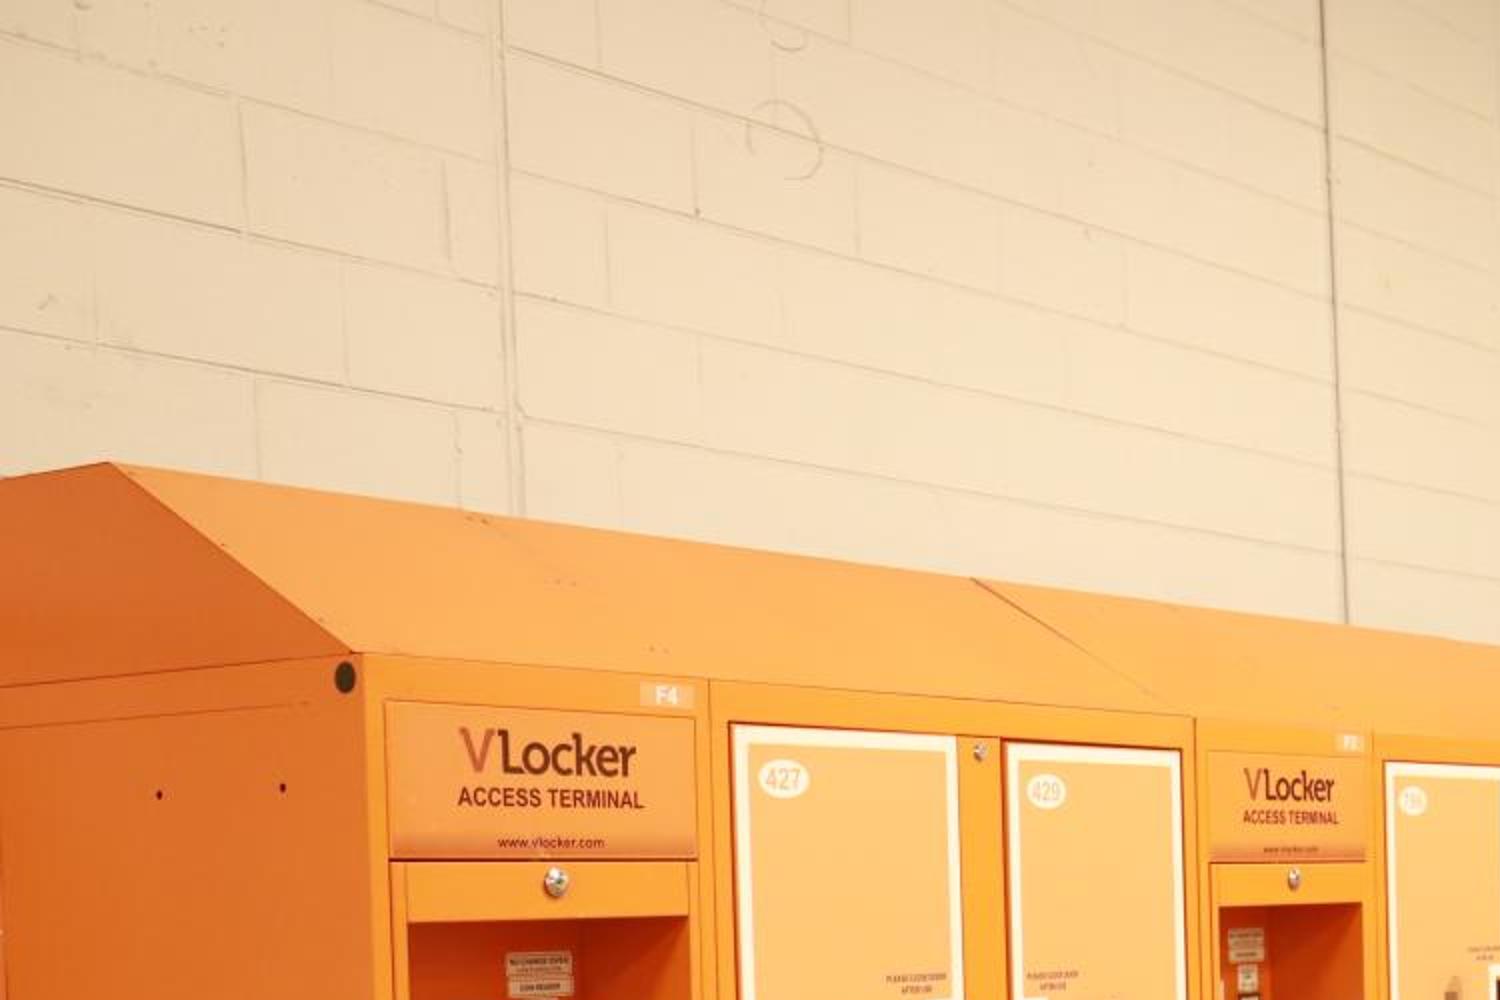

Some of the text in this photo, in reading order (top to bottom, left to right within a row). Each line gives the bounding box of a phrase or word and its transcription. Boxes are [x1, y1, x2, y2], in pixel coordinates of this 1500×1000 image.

[655, 685, 679, 706] F4
[459, 726, 638, 778] VLocker
[765, 767, 801, 793] 427
[1032, 780, 1062, 803] 429
[1243, 767, 1335, 803] VLocker
[457, 786, 646, 809] ACCESS TERMINAL
[1243, 809, 1341, 826] ACCESS TERMINAL
[496, 834, 606, 850] www.vlocker.com
